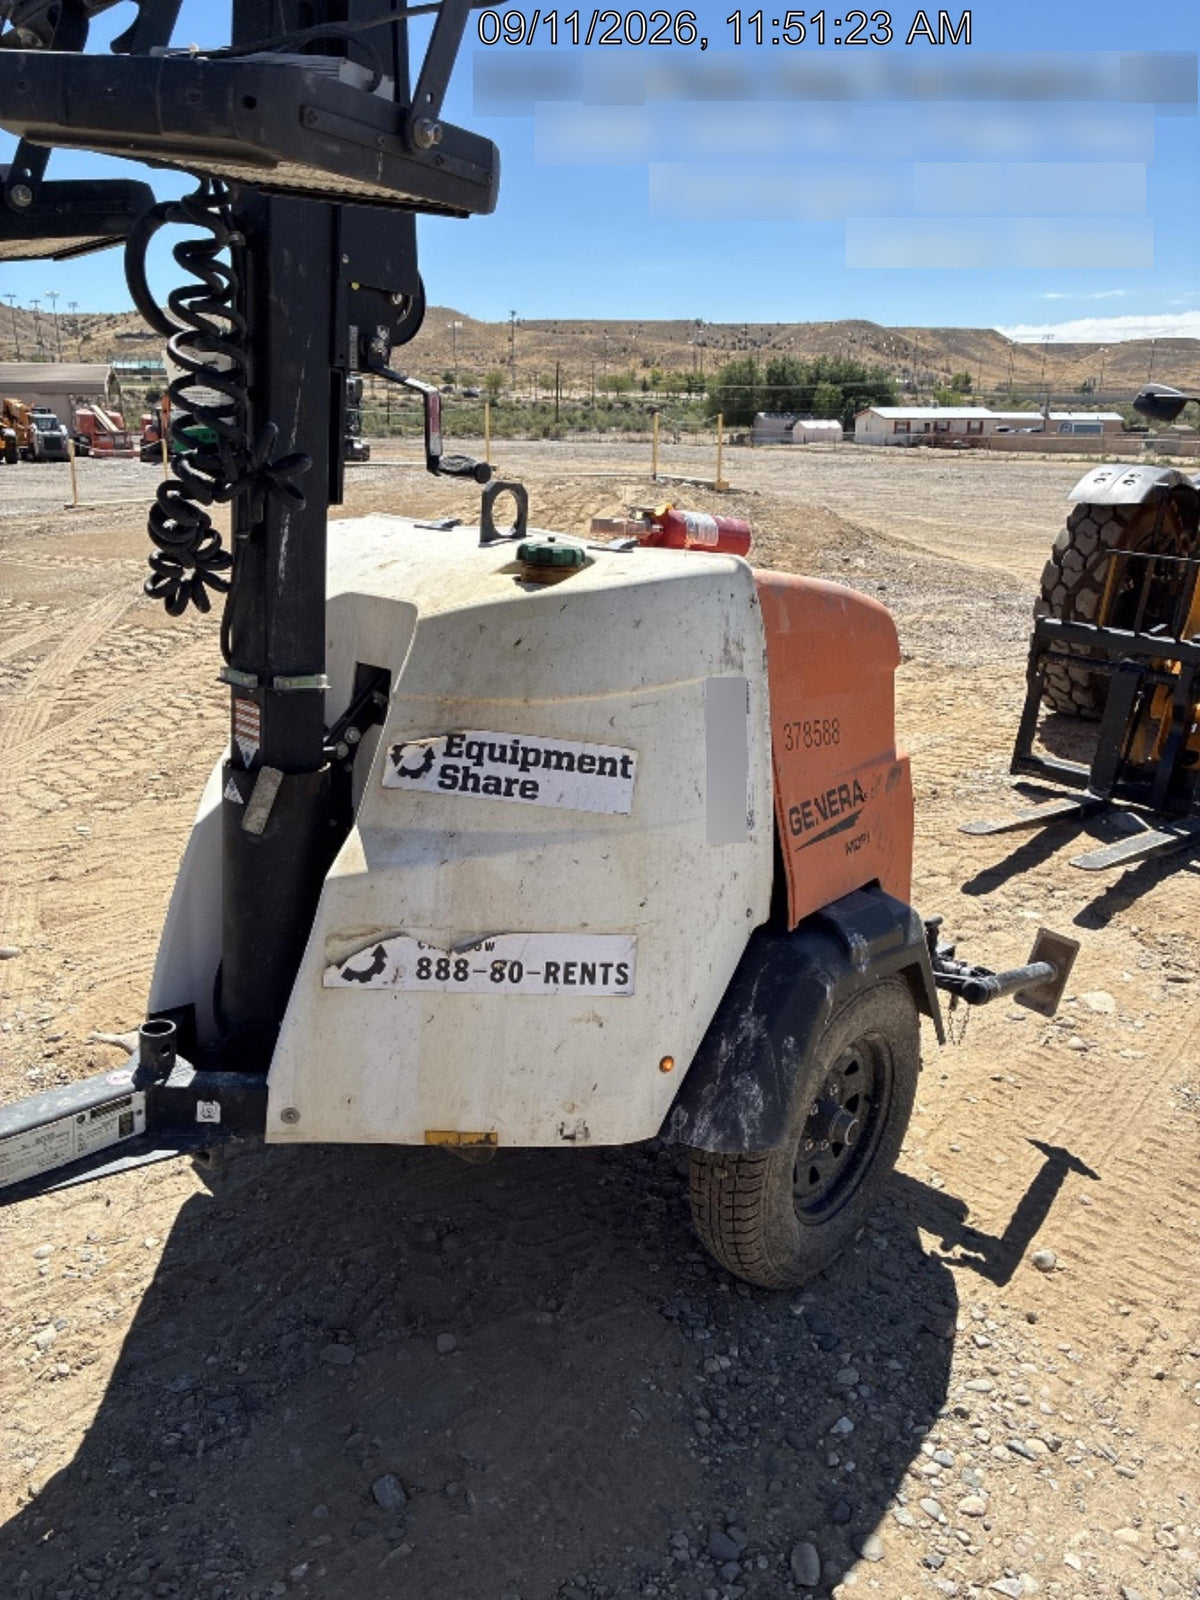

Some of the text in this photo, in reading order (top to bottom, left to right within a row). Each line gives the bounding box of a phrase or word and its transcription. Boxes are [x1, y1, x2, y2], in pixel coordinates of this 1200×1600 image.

[783, 718, 840, 751] 378588
[442, 733, 634, 779] Equipment
[438, 764, 540, 800] Share
[415, 956, 630, 986] 888-80-RENTS
